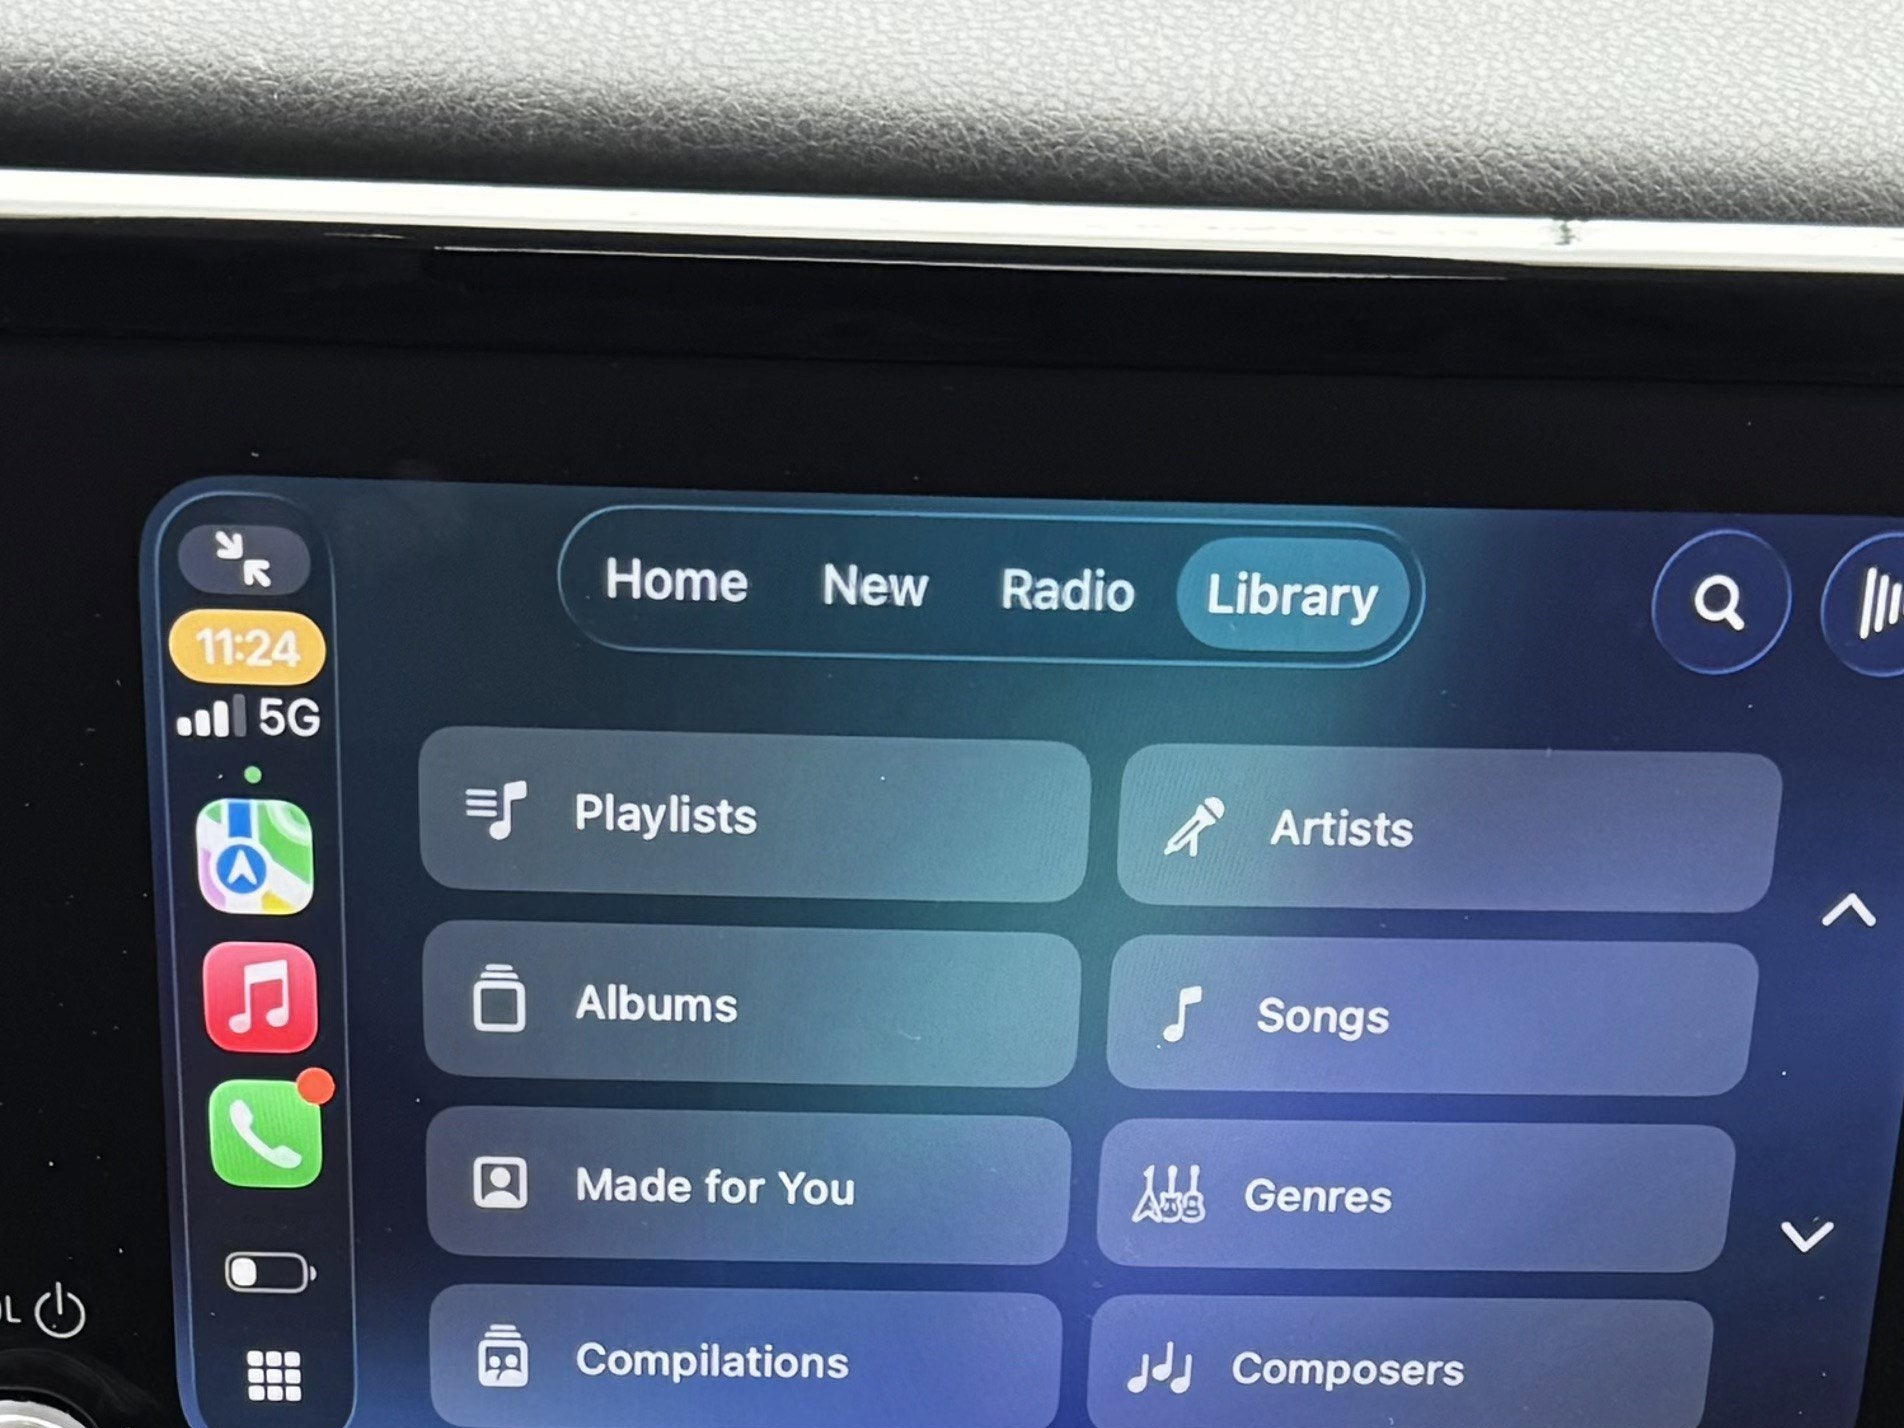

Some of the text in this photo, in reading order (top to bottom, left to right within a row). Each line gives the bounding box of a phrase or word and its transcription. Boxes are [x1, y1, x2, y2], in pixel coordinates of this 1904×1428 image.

[607, 556, 1379, 626] Home New Radio Library
[197, 628, 300, 667] 11:24
[259, 697, 321, 737] 5G
[576, 792, 757, 841] Playlists
[1270, 808, 1414, 848] Artists
[575, 983, 738, 1023] Albums
[1257, 996, 1390, 1042] Songs
[577, 1166, 855, 1206] Made for You
[1245, 1177, 1392, 1214] Genres
[576, 1342, 849, 1384] Compilations
[1232, 1350, 1464, 1392] Composers
